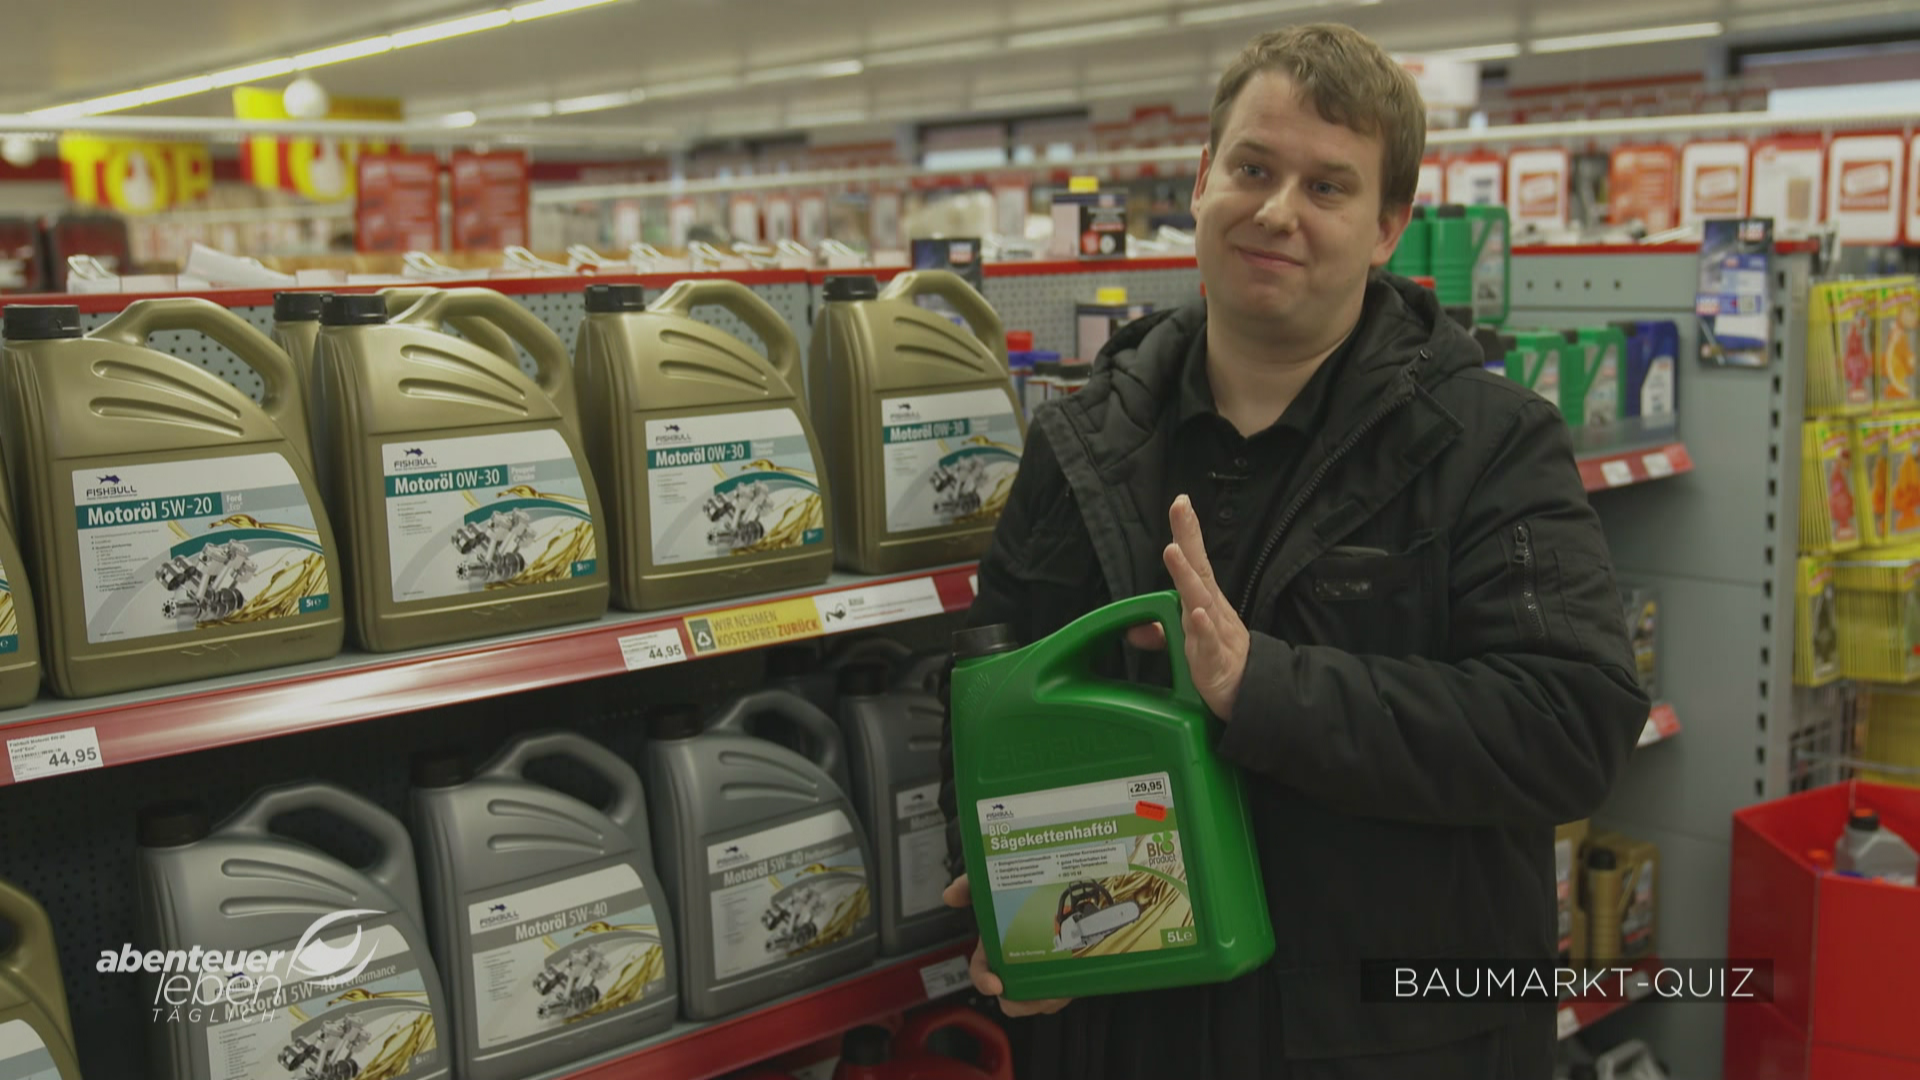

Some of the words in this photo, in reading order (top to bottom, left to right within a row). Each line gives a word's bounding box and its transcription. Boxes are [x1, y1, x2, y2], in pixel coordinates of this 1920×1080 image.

[58, 136, 212, 215] TOP
[890, 422, 934, 442] Motoröl
[394, 458, 437, 468] FISHBULL
[656, 447, 706, 467] Motoröl
[707, 444, 744, 460] 0W-30
[86, 485, 137, 497] FISHBULL
[395, 472, 454, 495] Motoröl
[456, 468, 500, 488] 0W-30
[226, 493, 242, 502] Ford
[88, 502, 157, 526] Motoröl
[161, 496, 212, 519] 5W-20
[712, 616, 734, 631] WIR
[735, 611, 777, 628] NEHMEN
[717, 628, 776, 646] KOSTENFREI
[777, 618, 820, 636] ZURÜCK
[649, 644, 682, 659] 44,95
[48, 746, 97, 766] 44,95
[989, 822, 1010, 836] BIO
[990, 820, 1118, 851] Sägekettenhaftöl
[1146, 840, 1174, 858] BIO
[724, 861, 768, 887] Motoröl
[770, 851, 804, 873] 5W-40
[1149, 853, 1176, 867] product
[516, 912, 567, 942] Motoröl
[568, 901, 608, 925] 5W-40
